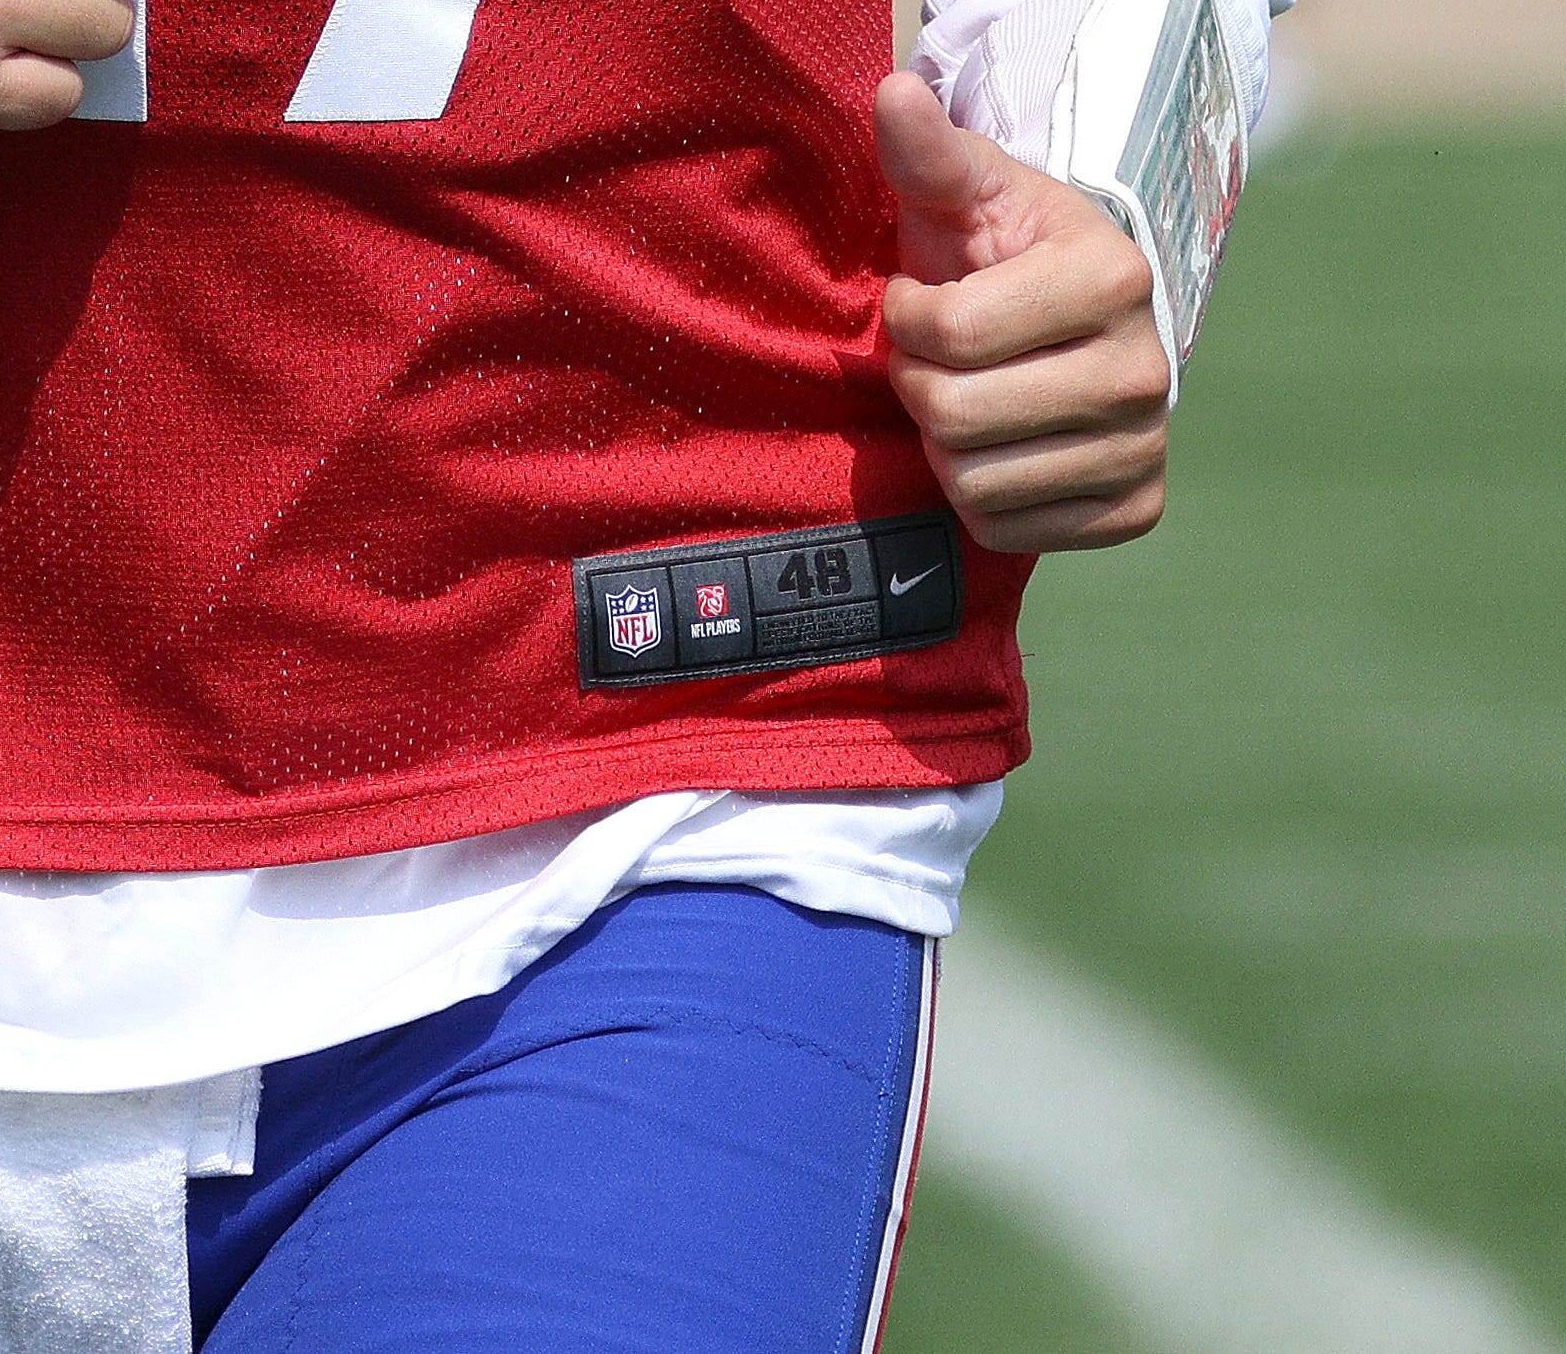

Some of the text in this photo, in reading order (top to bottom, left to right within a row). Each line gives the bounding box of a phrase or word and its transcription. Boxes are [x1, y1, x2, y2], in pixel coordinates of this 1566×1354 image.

[776, 546, 852, 600] 48
[616, 615, 654, 646] NFL
[691, 622, 706, 639] NFL
[707, 618, 741, 637] PLAYERS
